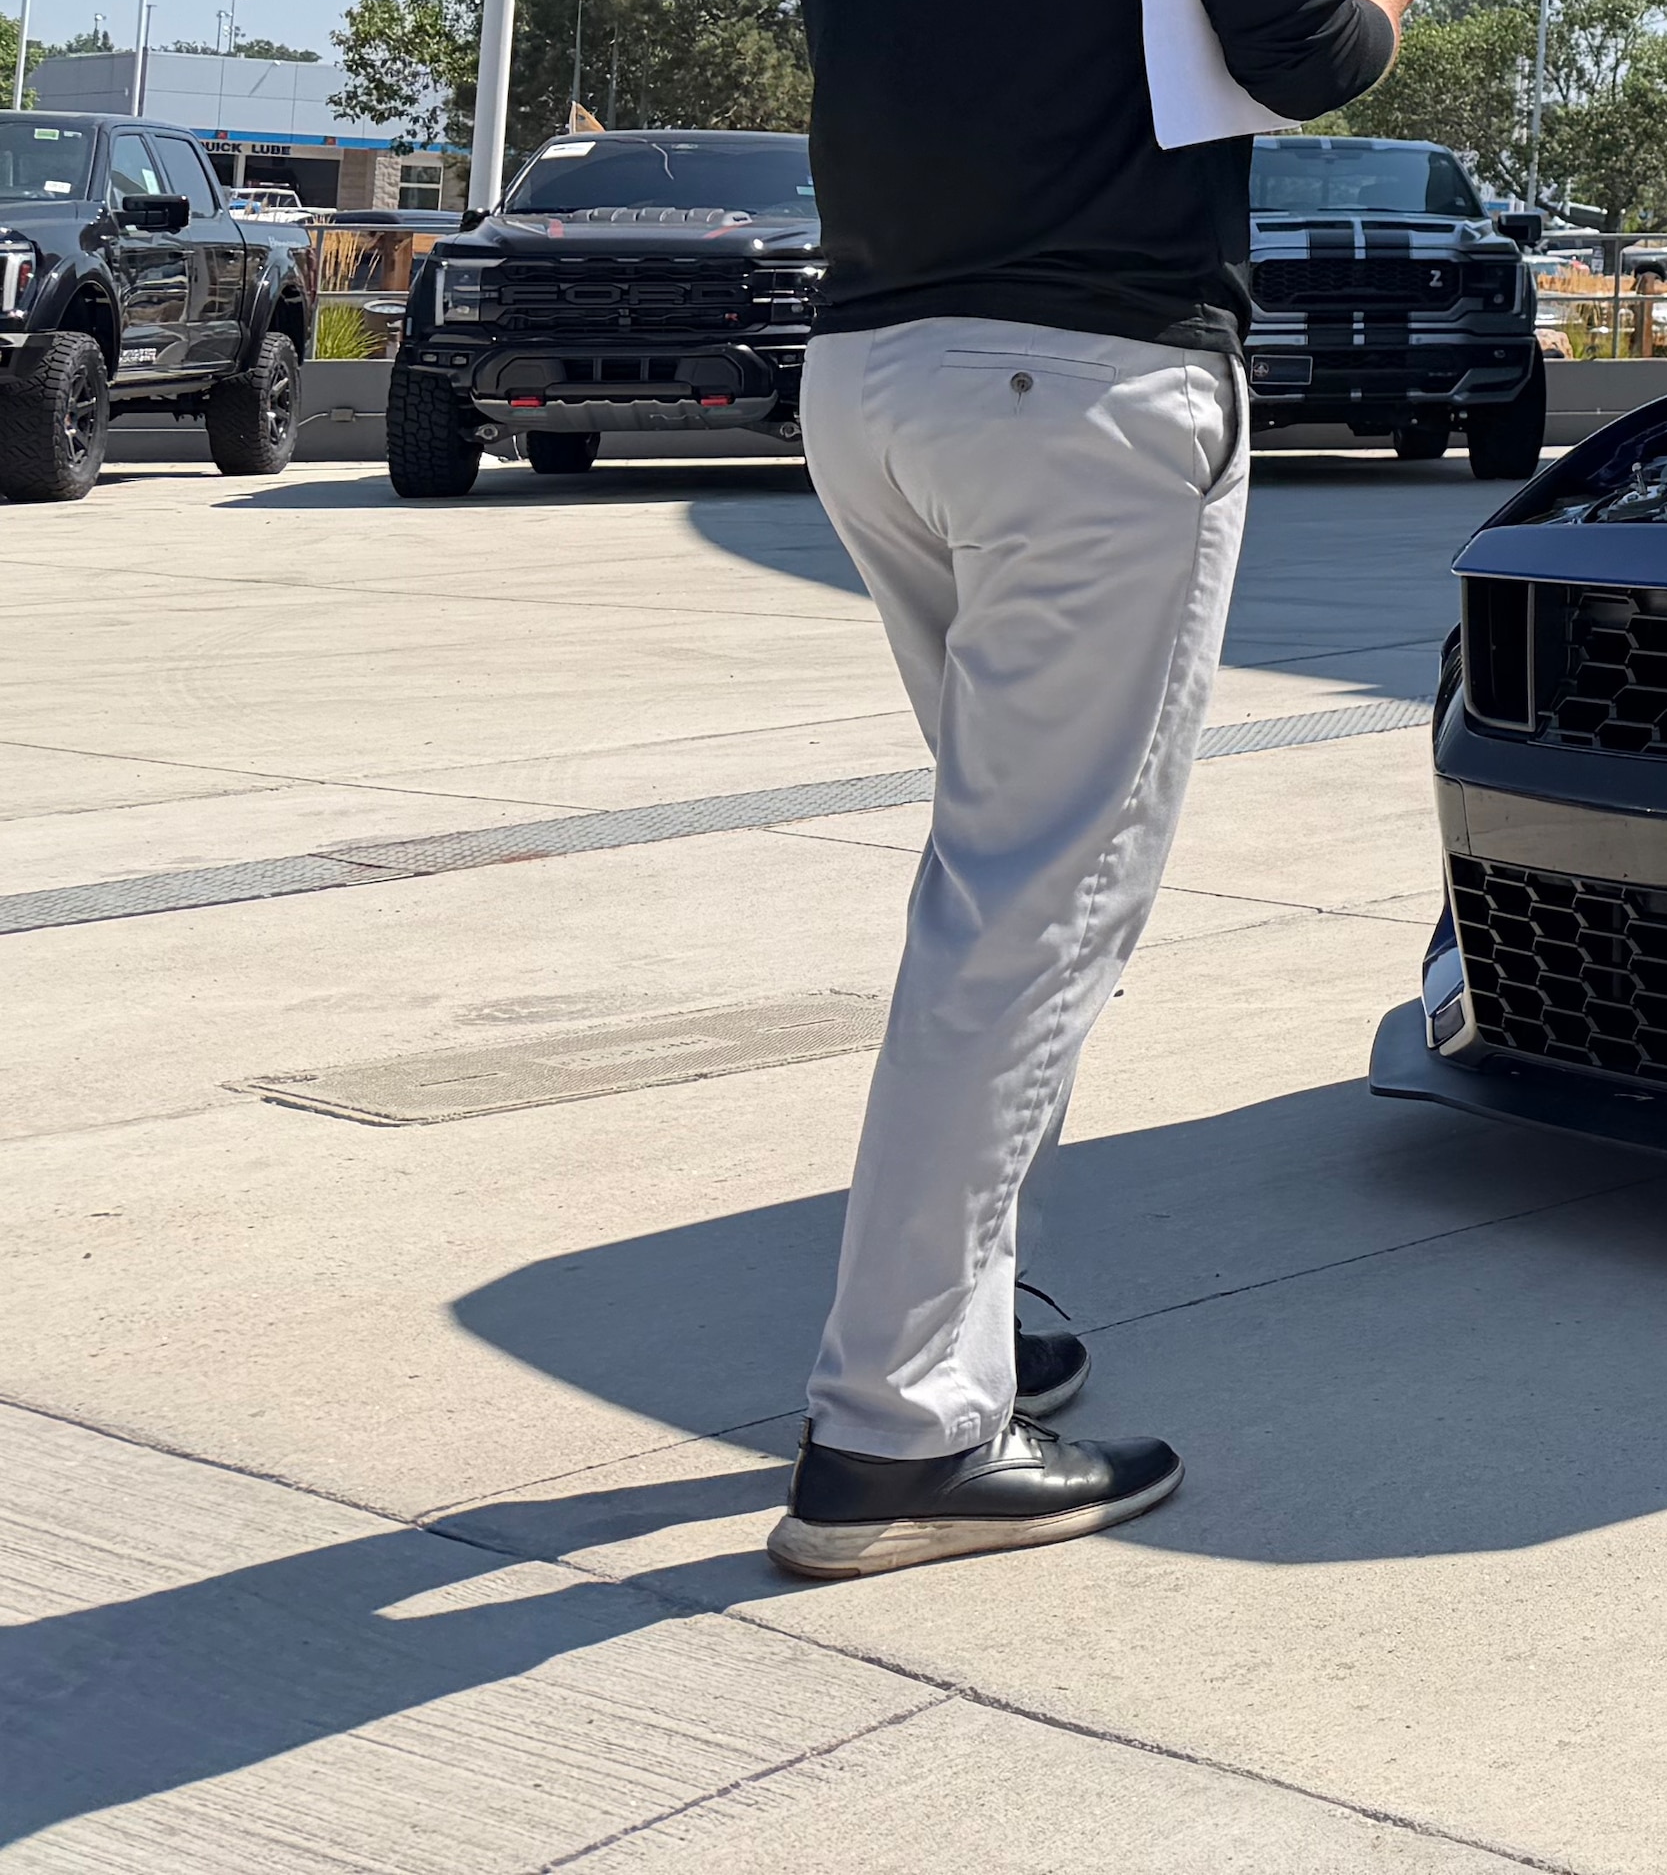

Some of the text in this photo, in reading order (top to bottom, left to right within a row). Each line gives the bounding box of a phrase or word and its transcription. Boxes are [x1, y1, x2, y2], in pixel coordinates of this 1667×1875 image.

[200, 141, 292, 156] UICK LUBE
[500, 283, 748, 306] FORD
